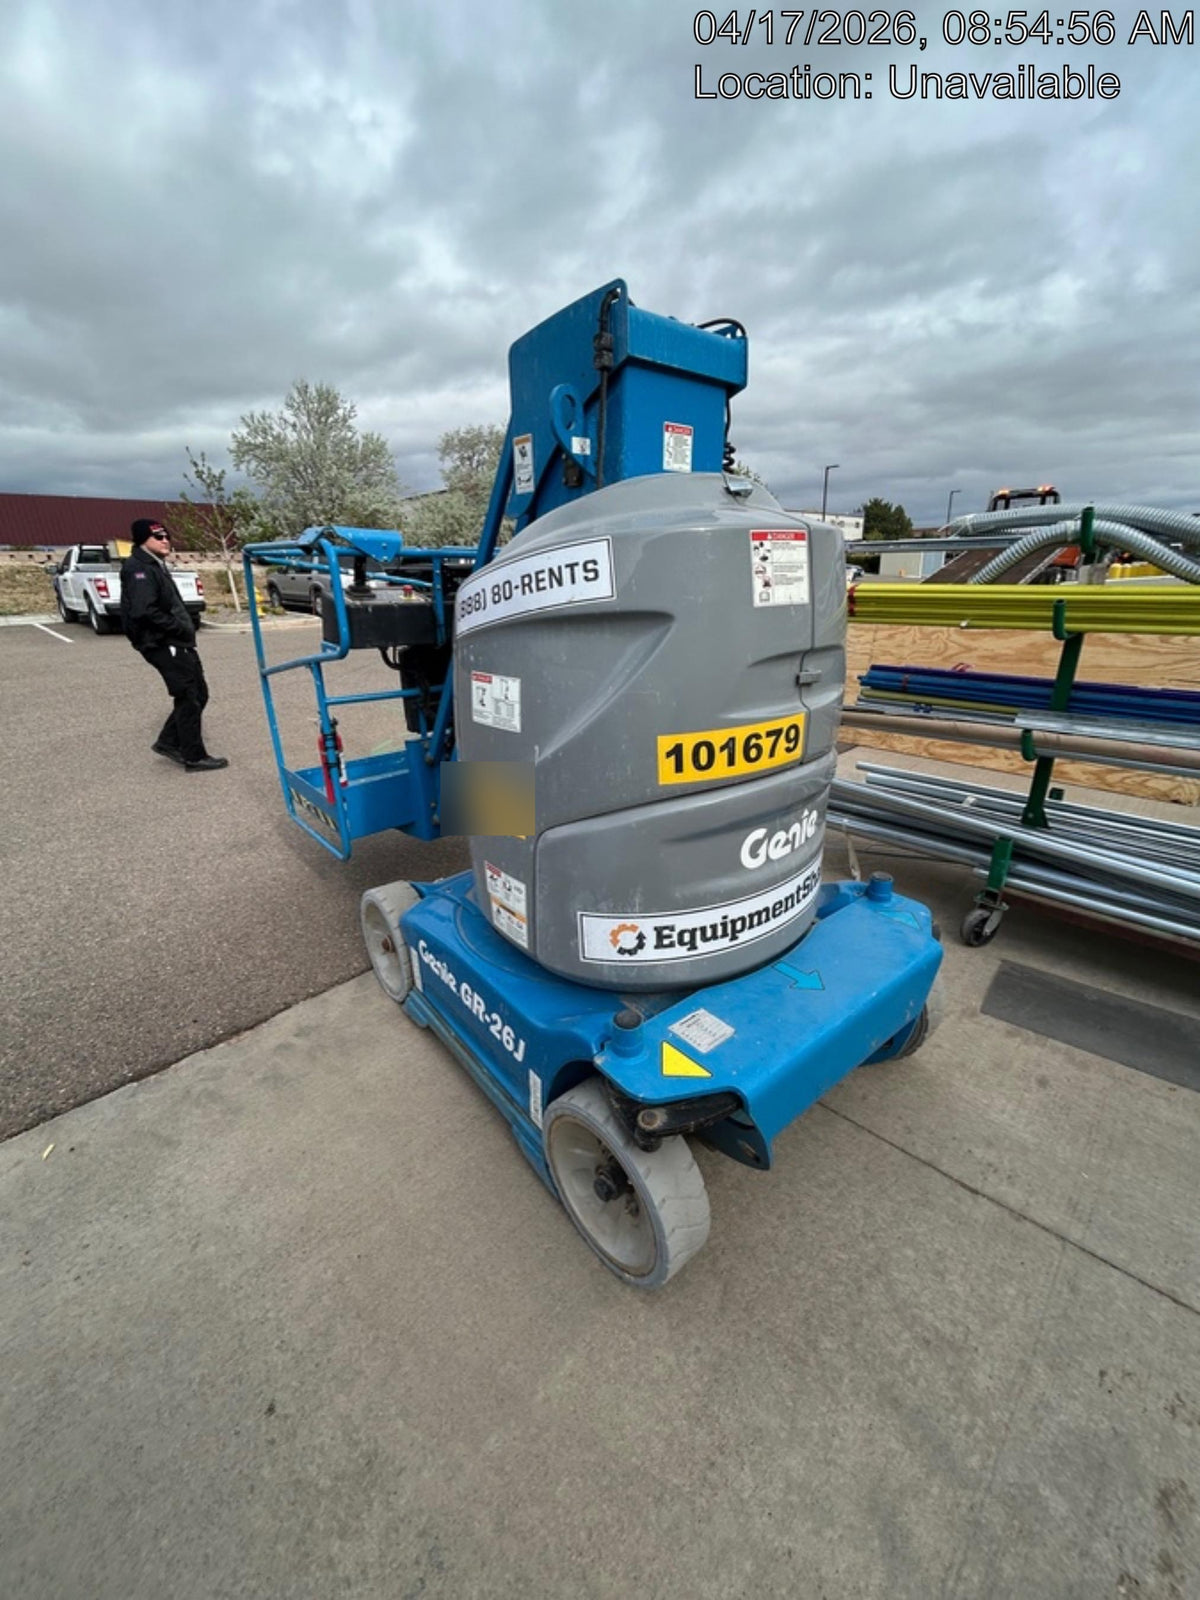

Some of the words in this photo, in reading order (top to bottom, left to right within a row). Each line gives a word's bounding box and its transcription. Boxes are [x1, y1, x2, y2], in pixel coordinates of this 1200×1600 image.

[491, 559, 600, 605] 80-RENTS
[665, 723, 800, 774] 101679
[740, 808, 818, 869] Genie
[418, 939, 458, 994] Genie
[460, 982, 526, 1062] GR-26J
